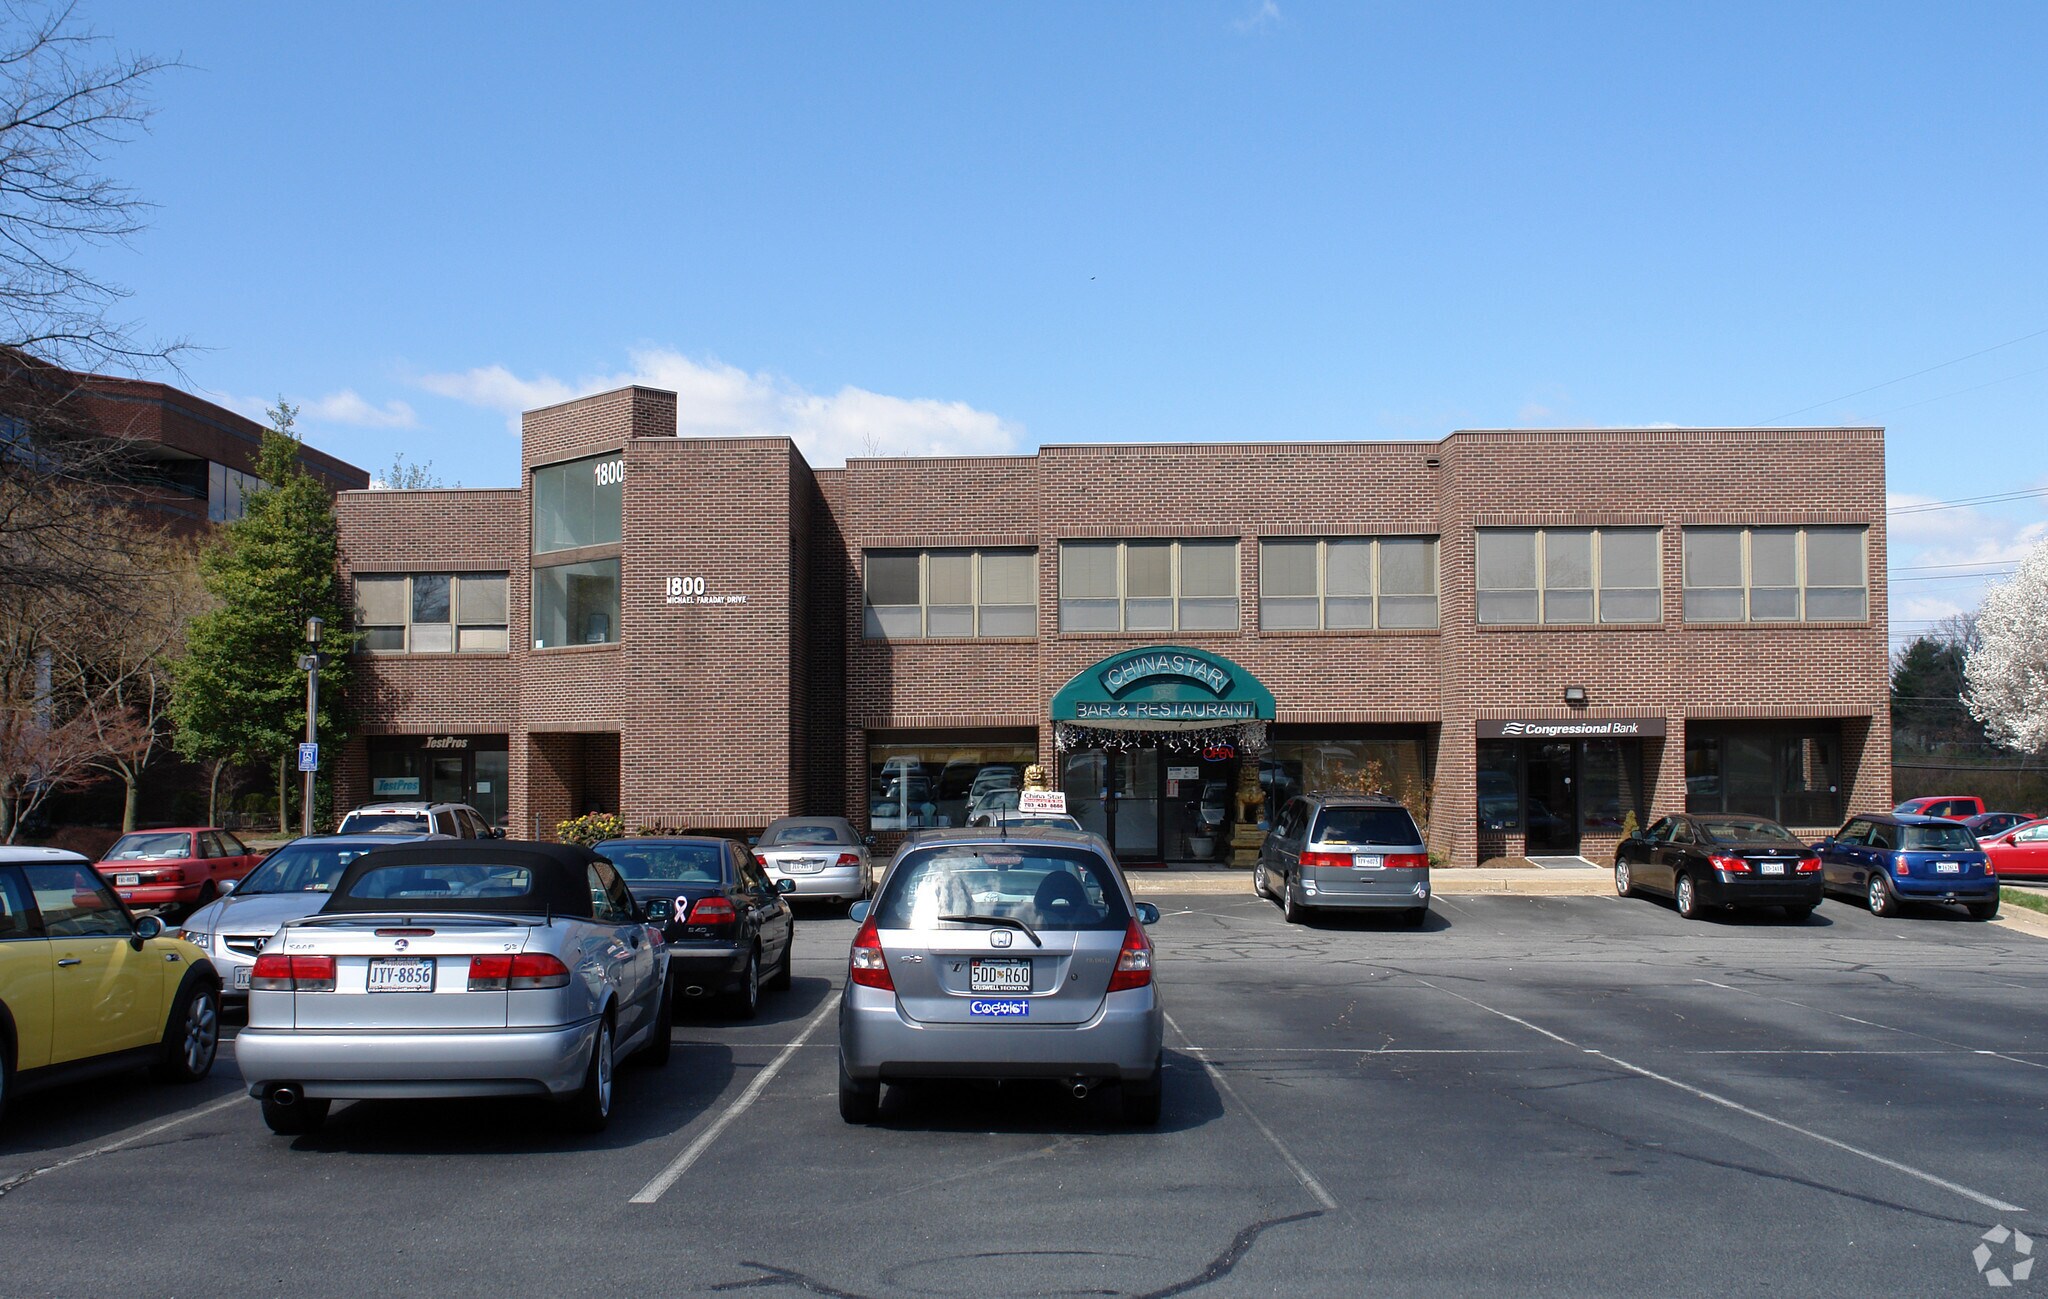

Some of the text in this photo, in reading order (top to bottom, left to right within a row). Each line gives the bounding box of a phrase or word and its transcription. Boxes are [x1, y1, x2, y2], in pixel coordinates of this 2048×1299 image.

[594, 460, 624, 486] 1800
[666, 577, 705, 596] 1800
[666, 596, 694, 604] MICHAEL
[697, 596, 725, 604] FARADAY
[1108, 655, 1224, 691] CHINASTAR
[1078, 701, 1252, 717] BAR & RESTAURANT
[1526, 722, 1638, 736] Congressional Bank
[426, 737, 468, 748] TestPros
[1203, 747, 1234, 759] OPEN
[378, 780, 418, 791] TestPros
[371, 967, 431, 983] JYV-8856
